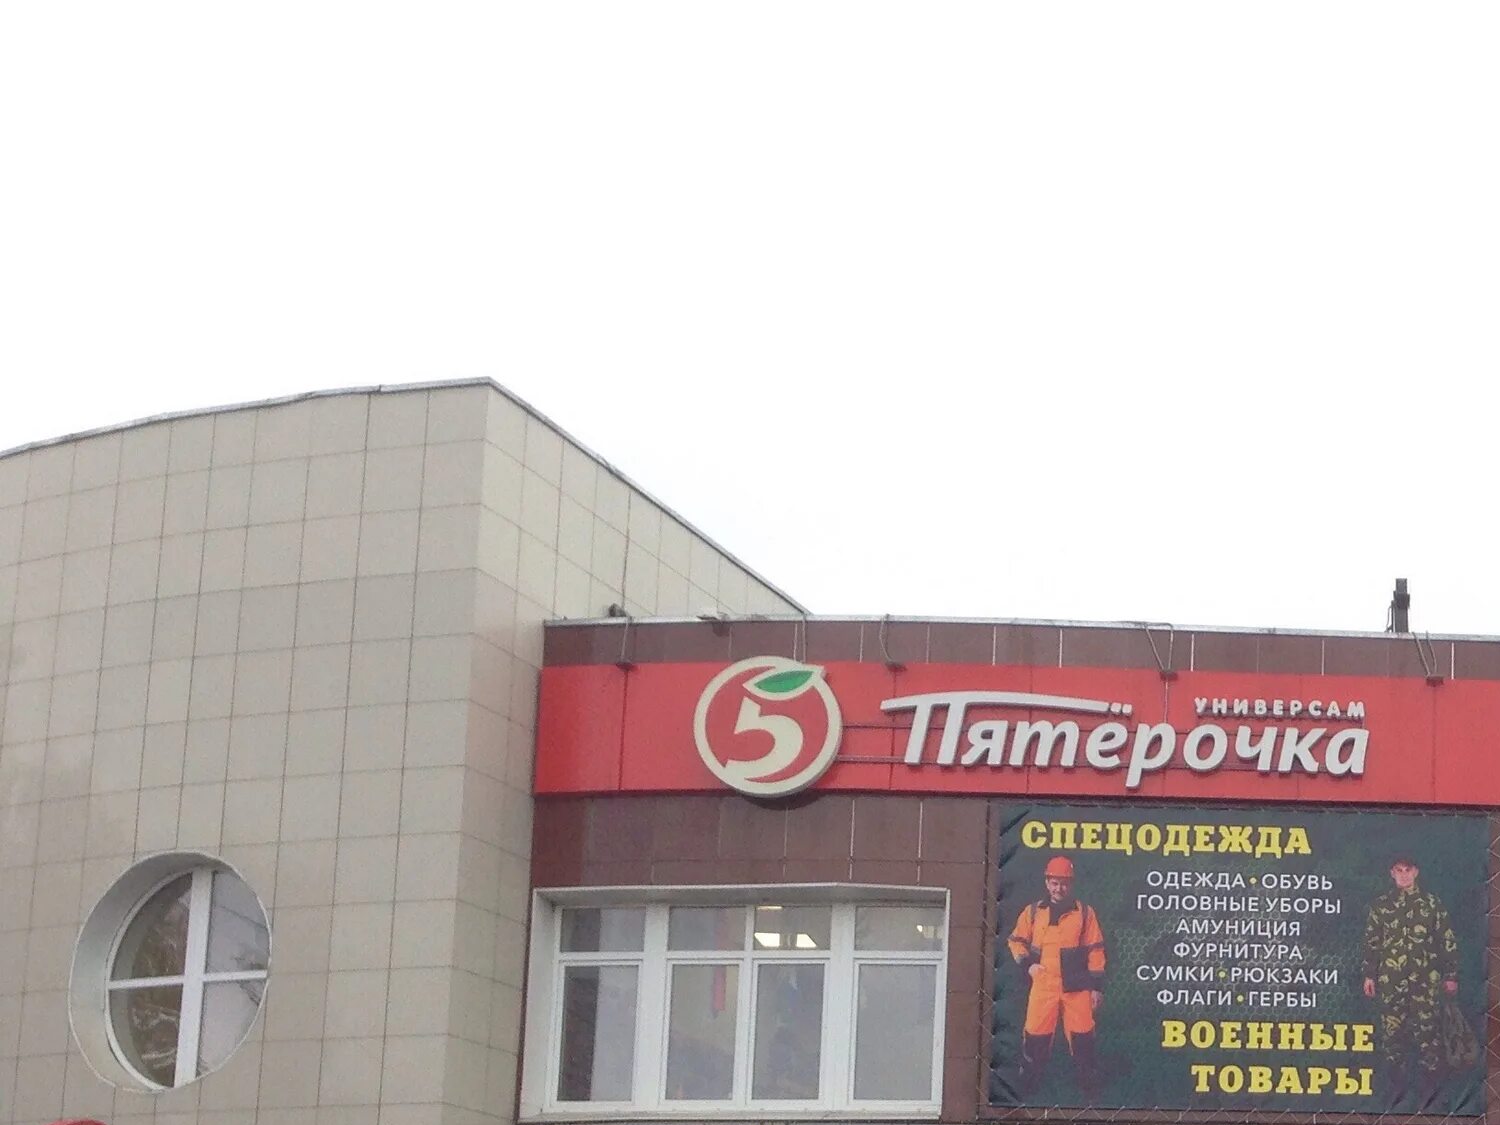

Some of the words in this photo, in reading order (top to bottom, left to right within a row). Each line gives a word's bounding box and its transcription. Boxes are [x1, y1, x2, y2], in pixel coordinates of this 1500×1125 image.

[1193, 696, 1366, 719] УНИВЕРСАМ
[880, 689, 1370, 789] Пятёрочка
[1020, 820, 1312, 859] СПЕЦОДЕЖДА
[1146, 870, 1246, 890] ОДЕЖДА
[1261, 872, 1333, 891] ОБУВЬ
[1136, 894, 1260, 914] ГОЛОВНЫЕ
[1265, 896, 1341, 915] УБОРЫ
[1175, 918, 1301, 940] АМУНИЦИЯ
[1173, 941, 1304, 961] ФУРНИТУРА
[1136, 963, 1215, 982] СУМКИ
[1230, 966, 1339, 985] РЮКЗАКИ
[1156, 987, 1232, 1007] ФЛАГИ
[1248, 989, 1317, 1008] ГЕРБЫ
[1161, 1019, 1375, 1052] ВОЕННЫЕ
[1190, 1064, 1374, 1097] ТОВАРЫ
